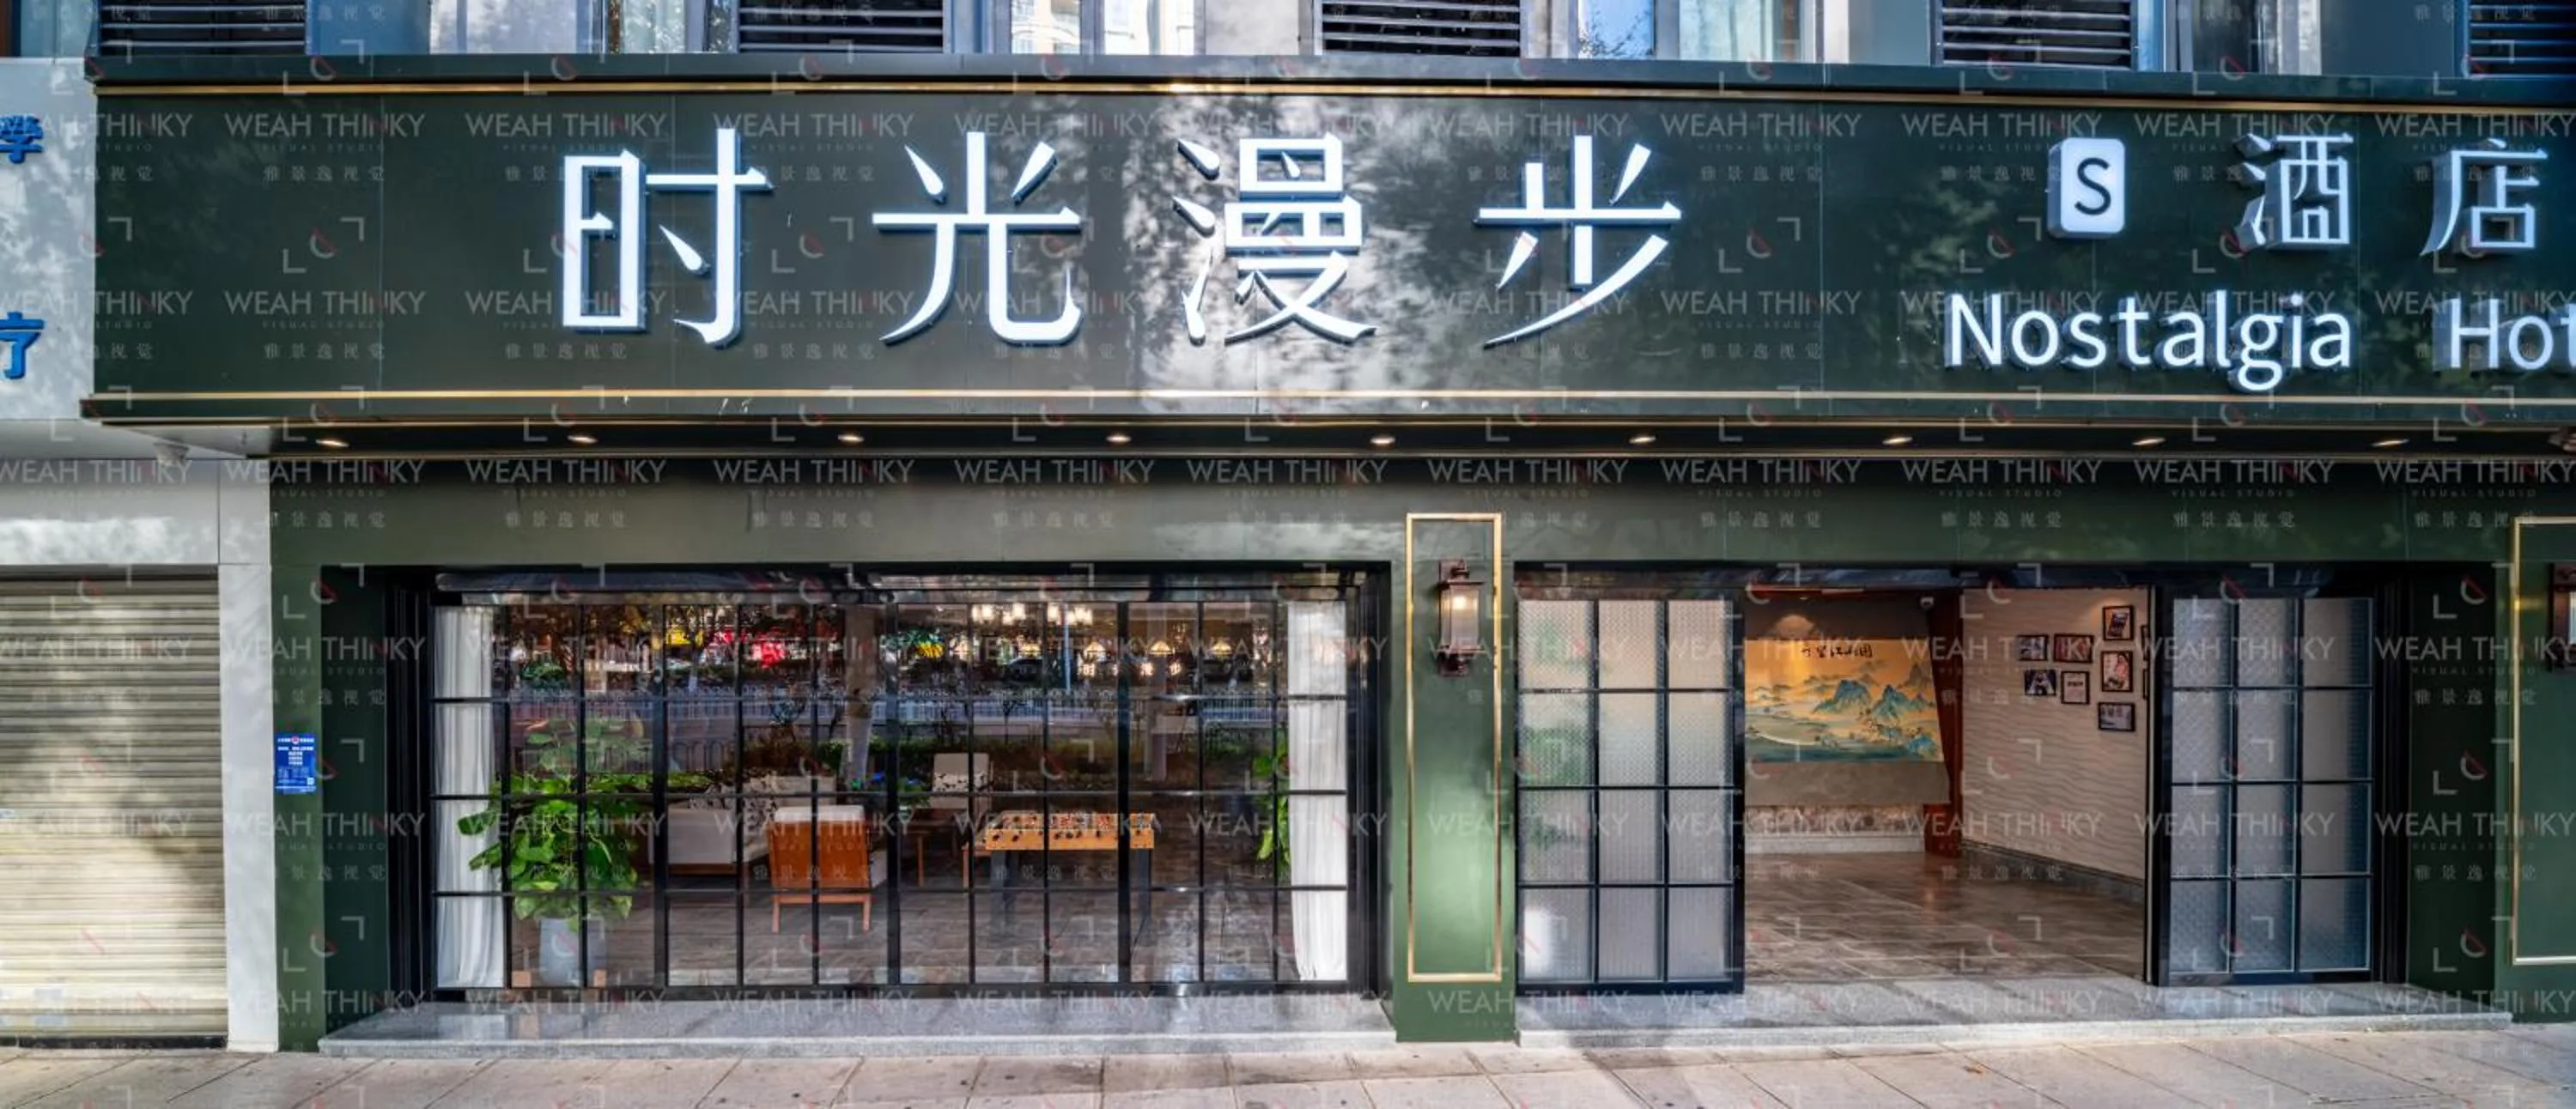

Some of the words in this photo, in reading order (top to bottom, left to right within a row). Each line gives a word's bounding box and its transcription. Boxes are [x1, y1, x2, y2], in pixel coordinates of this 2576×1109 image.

[560, 128, 1682, 347] 时光漫步
[2239, 132, 2549, 254] 酒店
[1947, 292, 2352, 392] Nostalgia
